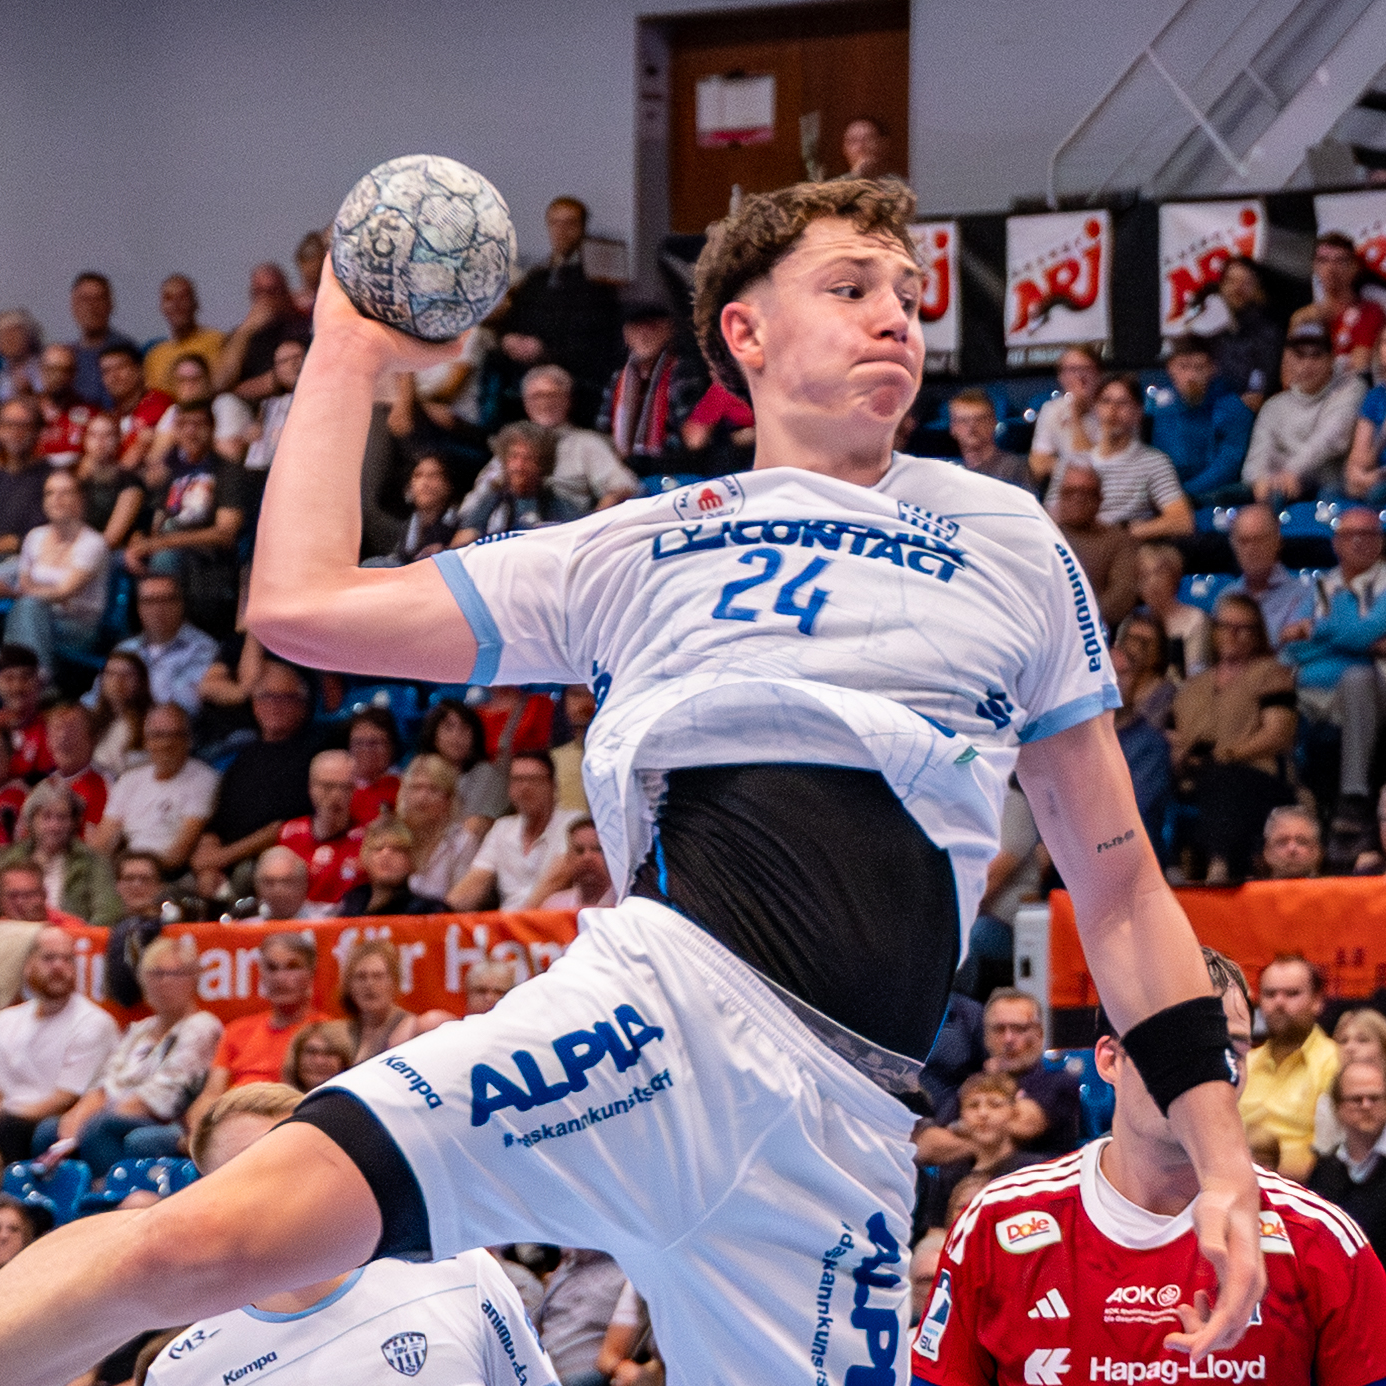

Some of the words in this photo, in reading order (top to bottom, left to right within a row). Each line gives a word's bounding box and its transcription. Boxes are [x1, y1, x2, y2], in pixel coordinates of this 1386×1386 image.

[711, 548, 833, 637] 24
[380, 1053, 444, 1111] Kempa
[1006, 1217, 1050, 1243] Dole
[1105, 1287, 1156, 1305] AOK
[222, 1351, 278, 1386] Kempa
[1089, 1354, 1266, 1386] Hapag-Lloyd
